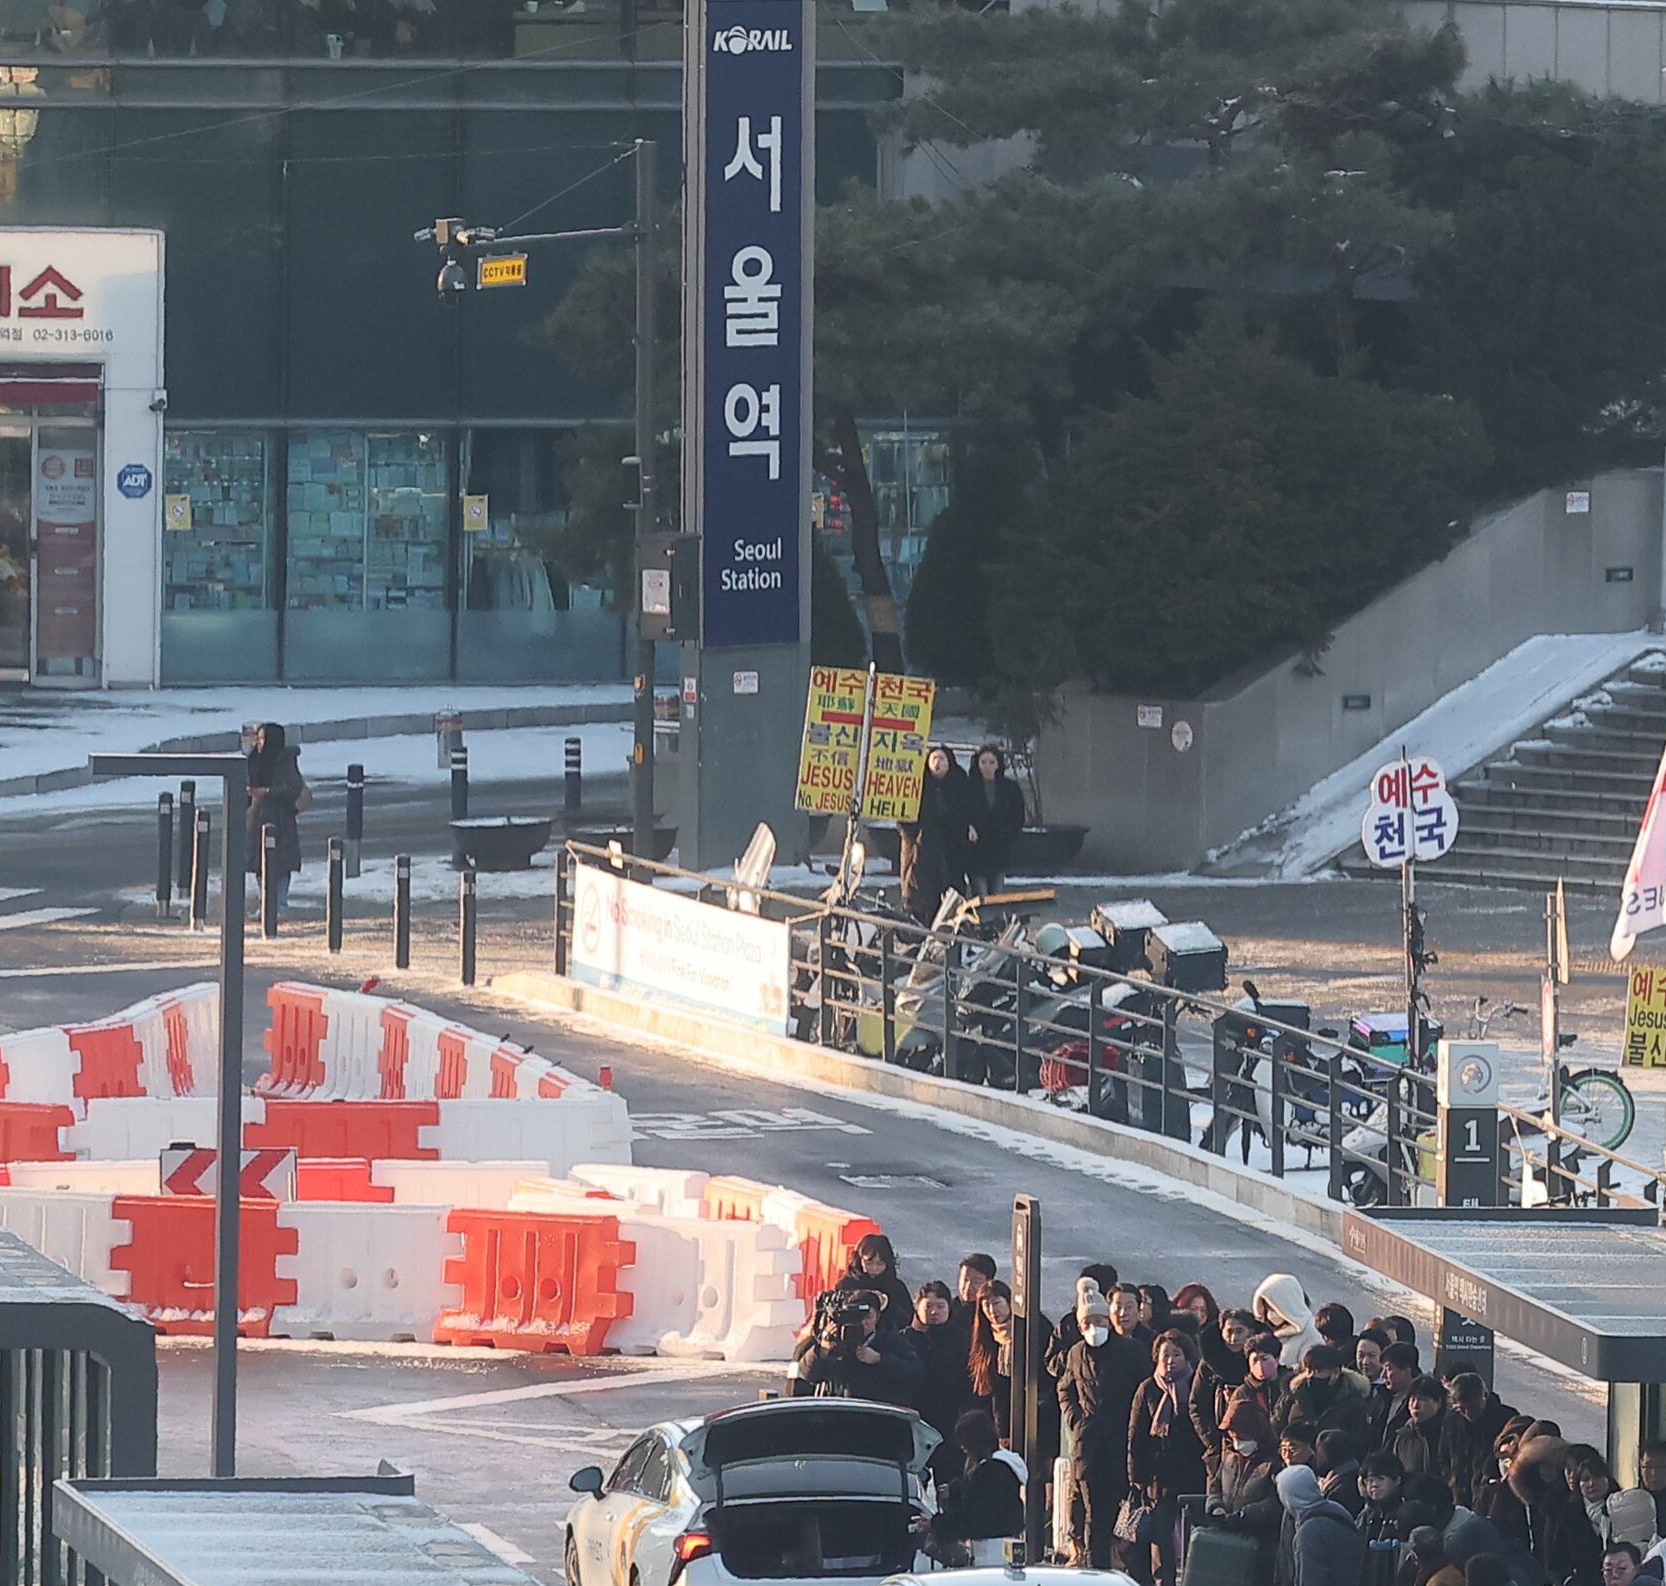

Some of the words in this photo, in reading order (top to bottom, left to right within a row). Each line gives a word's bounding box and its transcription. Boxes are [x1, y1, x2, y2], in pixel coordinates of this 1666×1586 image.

[713, 25, 793, 55] KORAIL
[483, 265, 505, 280] CCTV
[723, 115, 783, 480] 서울역
[122, 473, 147, 488] ADT
[734, 537, 782, 563] Seoul
[721, 567, 782, 591] Station
[812, 670, 865, 696] 예수
[879, 676, 933, 704] 천국
[808, 721, 860, 749] 불신
[873, 731, 926, 757] 지옥
[801, 762, 855, 792] JESUS
[866, 772, 921, 799] HEAVEN
[1378, 763, 1440, 809] 예수
[815, 792, 853, 812] JESUS
[869, 798, 911, 819] HELL
[1374, 806, 1447, 861] 천국
[1463, 1119, 1481, 1151] 1
